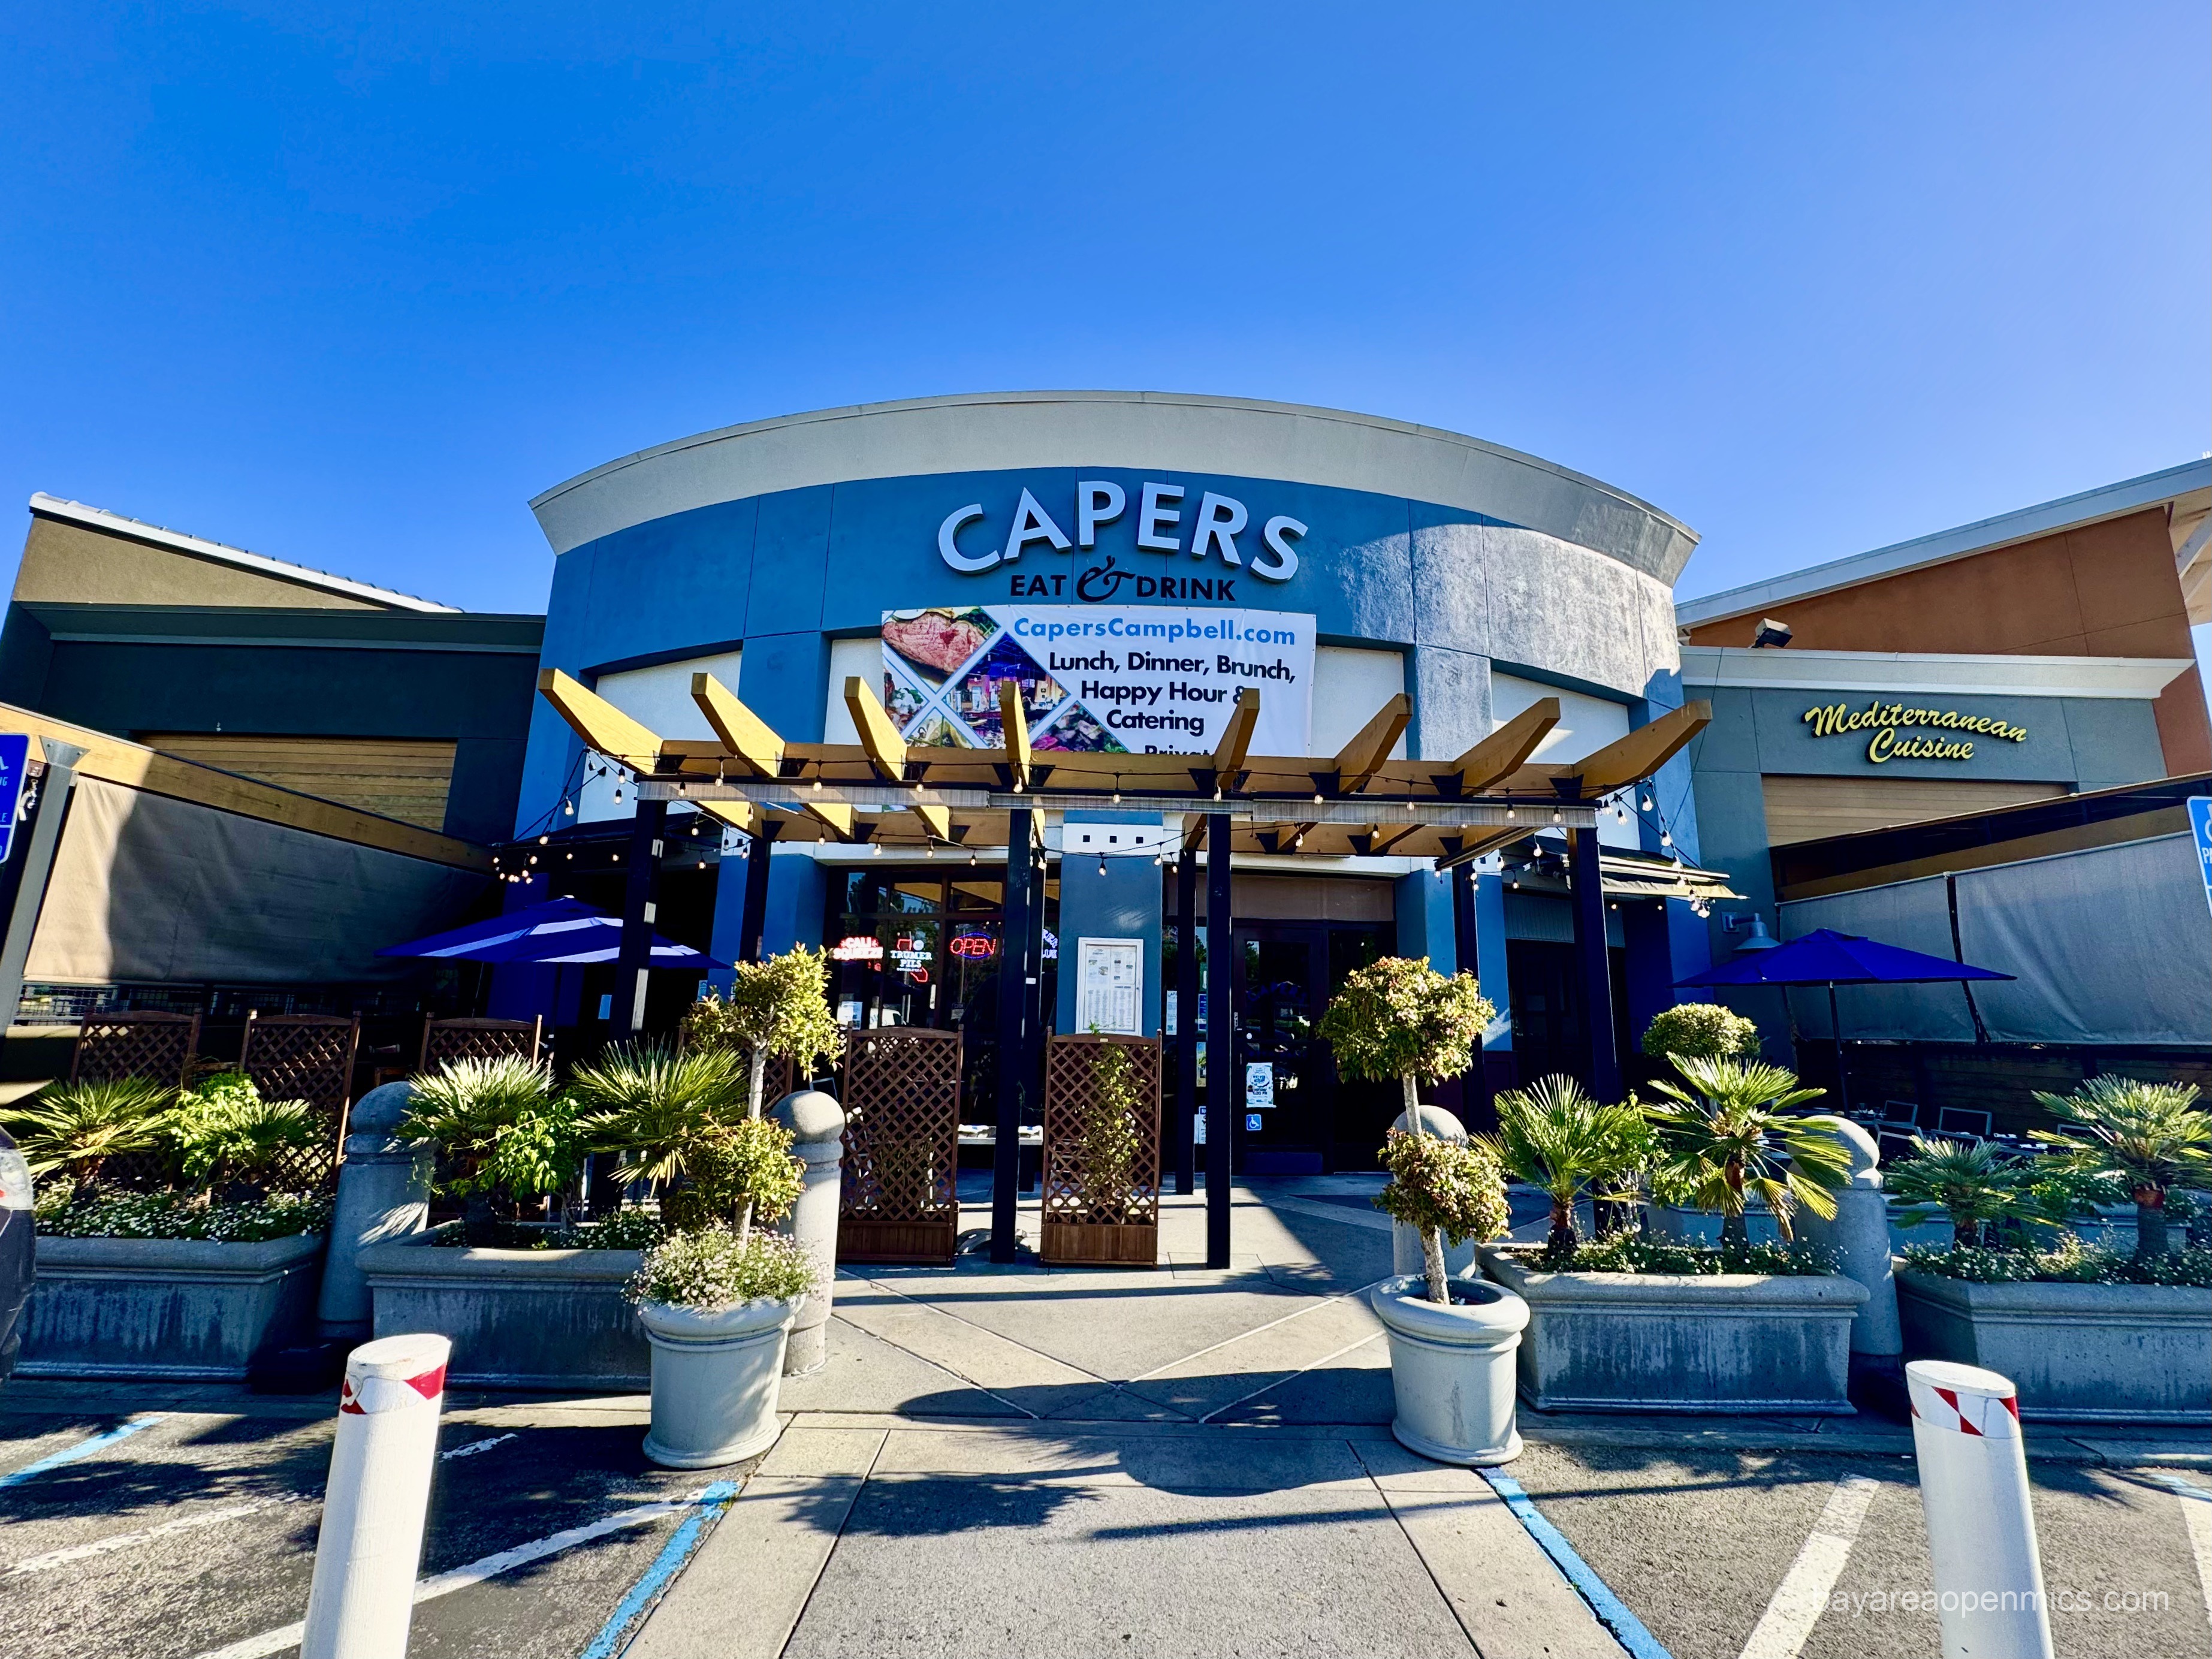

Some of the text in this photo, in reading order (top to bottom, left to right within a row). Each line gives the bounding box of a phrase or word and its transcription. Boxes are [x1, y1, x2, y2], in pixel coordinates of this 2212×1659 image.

[938, 481, 1308, 581] CAPERS
[1010, 555, 1236, 602] EAT & DRINK
[1014, 617, 1295, 645] CapersCampbell.com
[1049, 650, 1296, 684] Lunch, Dinner, Brunch,
[1081, 680, 1163, 705] Happy
[1169, 681, 1227, 703] Hour
[1106, 709, 1205, 737] Catering
[1805, 701, 2027, 742] Mediterranean
[1869, 728, 1975, 763] Cuisine
[846, 937, 872, 948] CALI
[890, 950, 933, 960] TRUMER
[949, 937, 997, 955] OPEN
[900, 959, 922, 969] PILS
